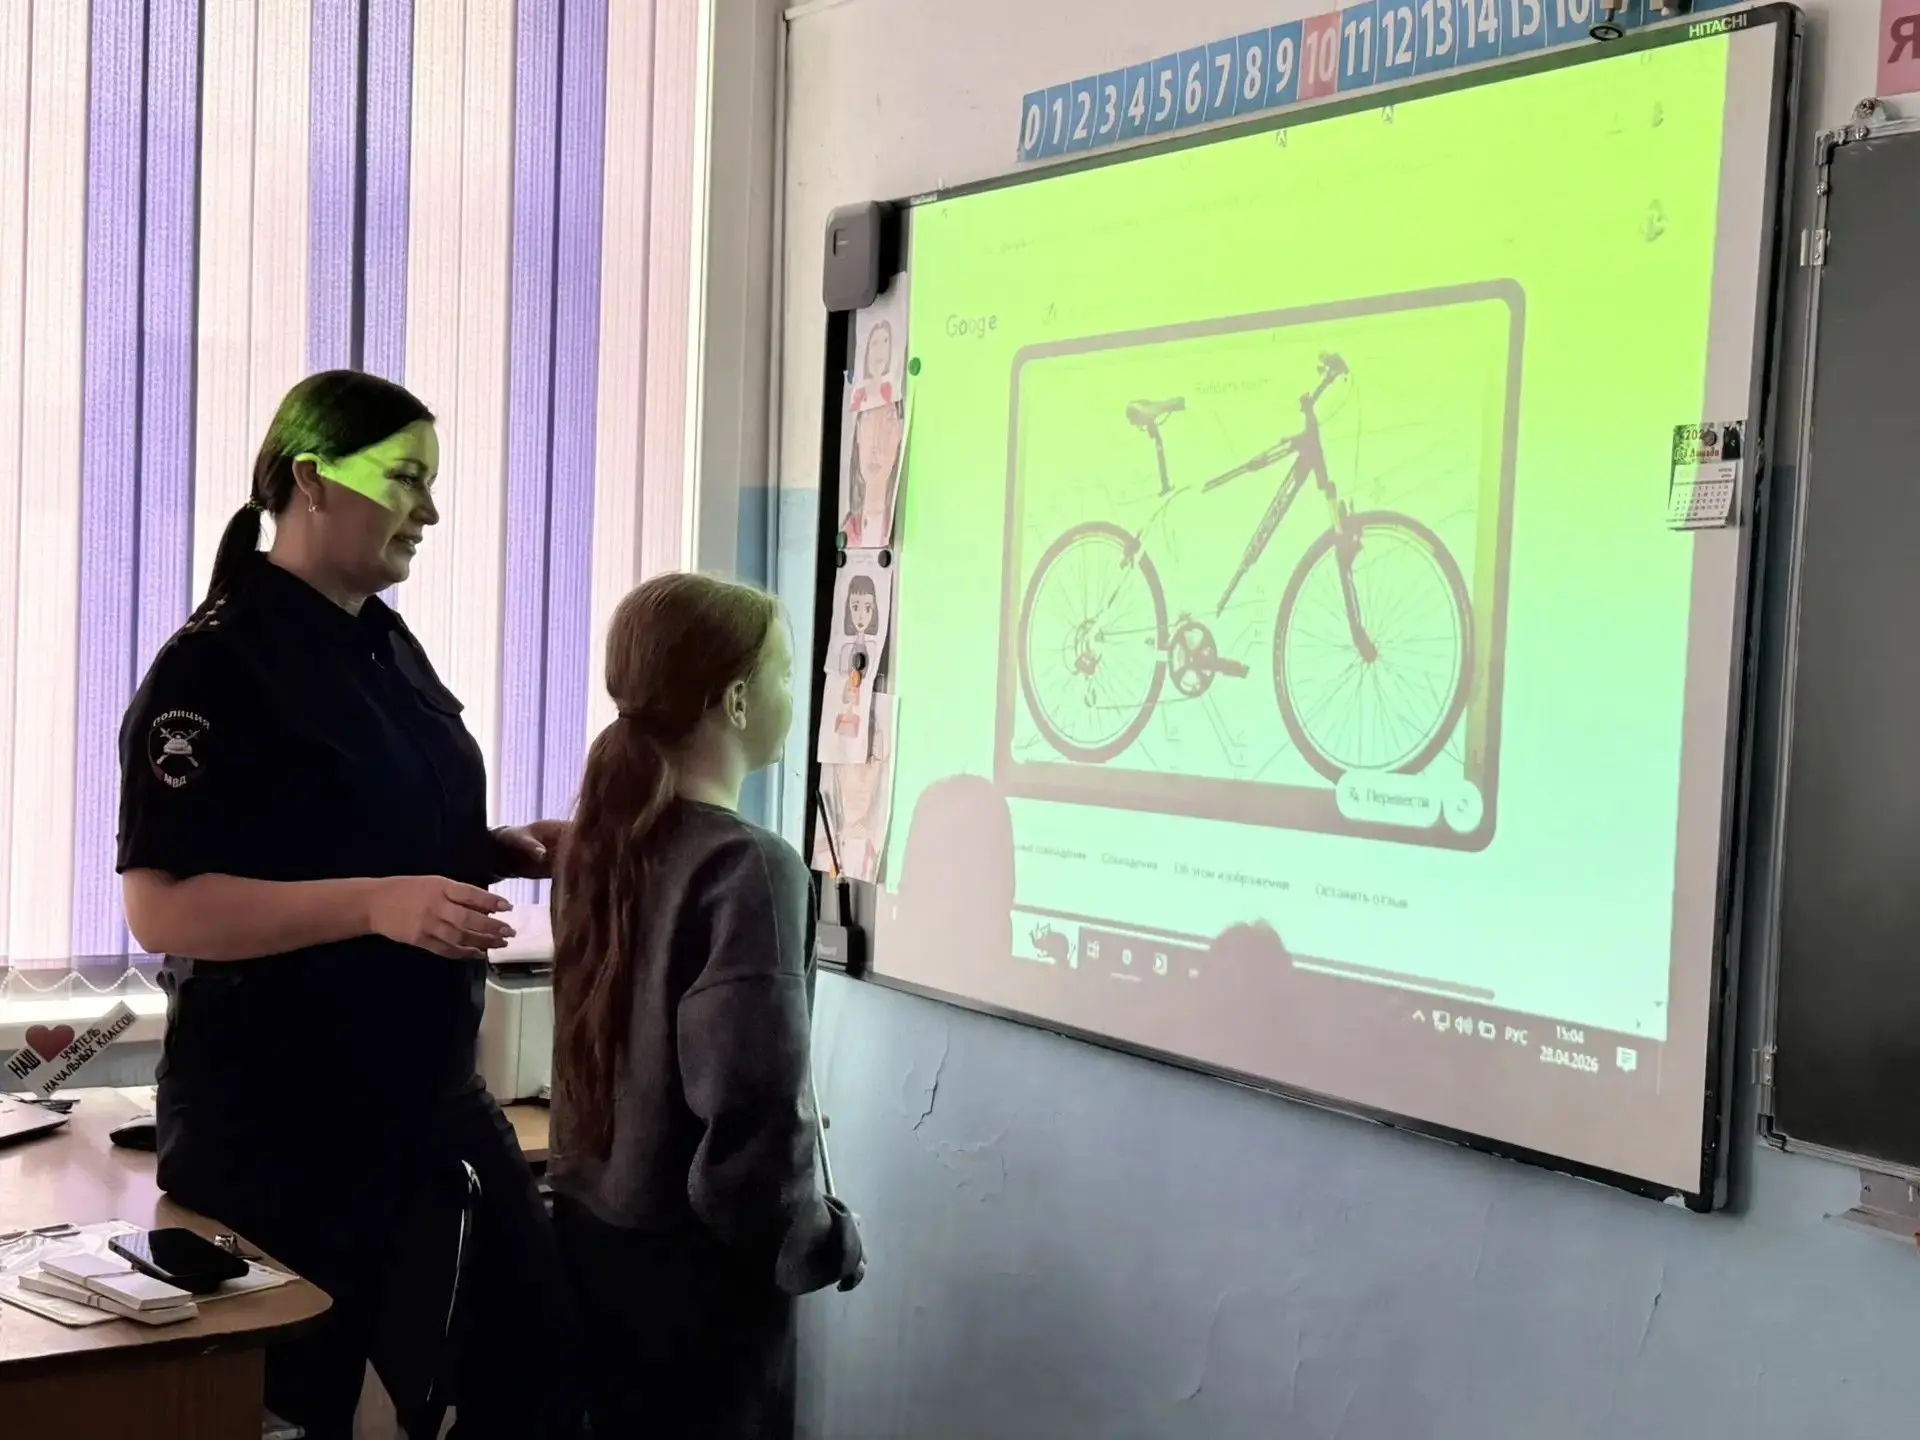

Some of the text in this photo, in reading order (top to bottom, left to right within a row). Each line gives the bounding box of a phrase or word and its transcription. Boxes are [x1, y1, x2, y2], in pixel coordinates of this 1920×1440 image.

[1689, 13, 1747, 38] HITACHI
[1887, 13, 1920, 64] Я
[1024, 104, 1040, 150] 0
[1052, 98, 1062, 144] 1
[1073, 91, 1090, 140] 2
[1100, 85, 1116, 134] 3
[1128, 77, 1144, 126] 4
[1155, 70, 1172, 121] 5
[1185, 61, 1201, 114] 6
[1214, 53, 1231, 107] 7
[1244, 46, 1262, 99] 8
[1276, 37, 1293, 93] 9
[1306, 27, 1337, 84] 10
[1345, 17, 1371, 76] 11
[1382, 6, 1413, 67] 12
[1421, 0, 1452, 58] 13
[1463, 0, 1498, 48] 14
[153, 710, 210, 730] ПОЛИЦИЯ
[60, 1028, 103, 1061] УЧИТЕЛЬ
[1505, 1026, 1528, 1046] РУС
[7, 1048, 41, 1079] НАШ
[42, 1047, 98, 1093] НАЧАЛЬНЫХ
